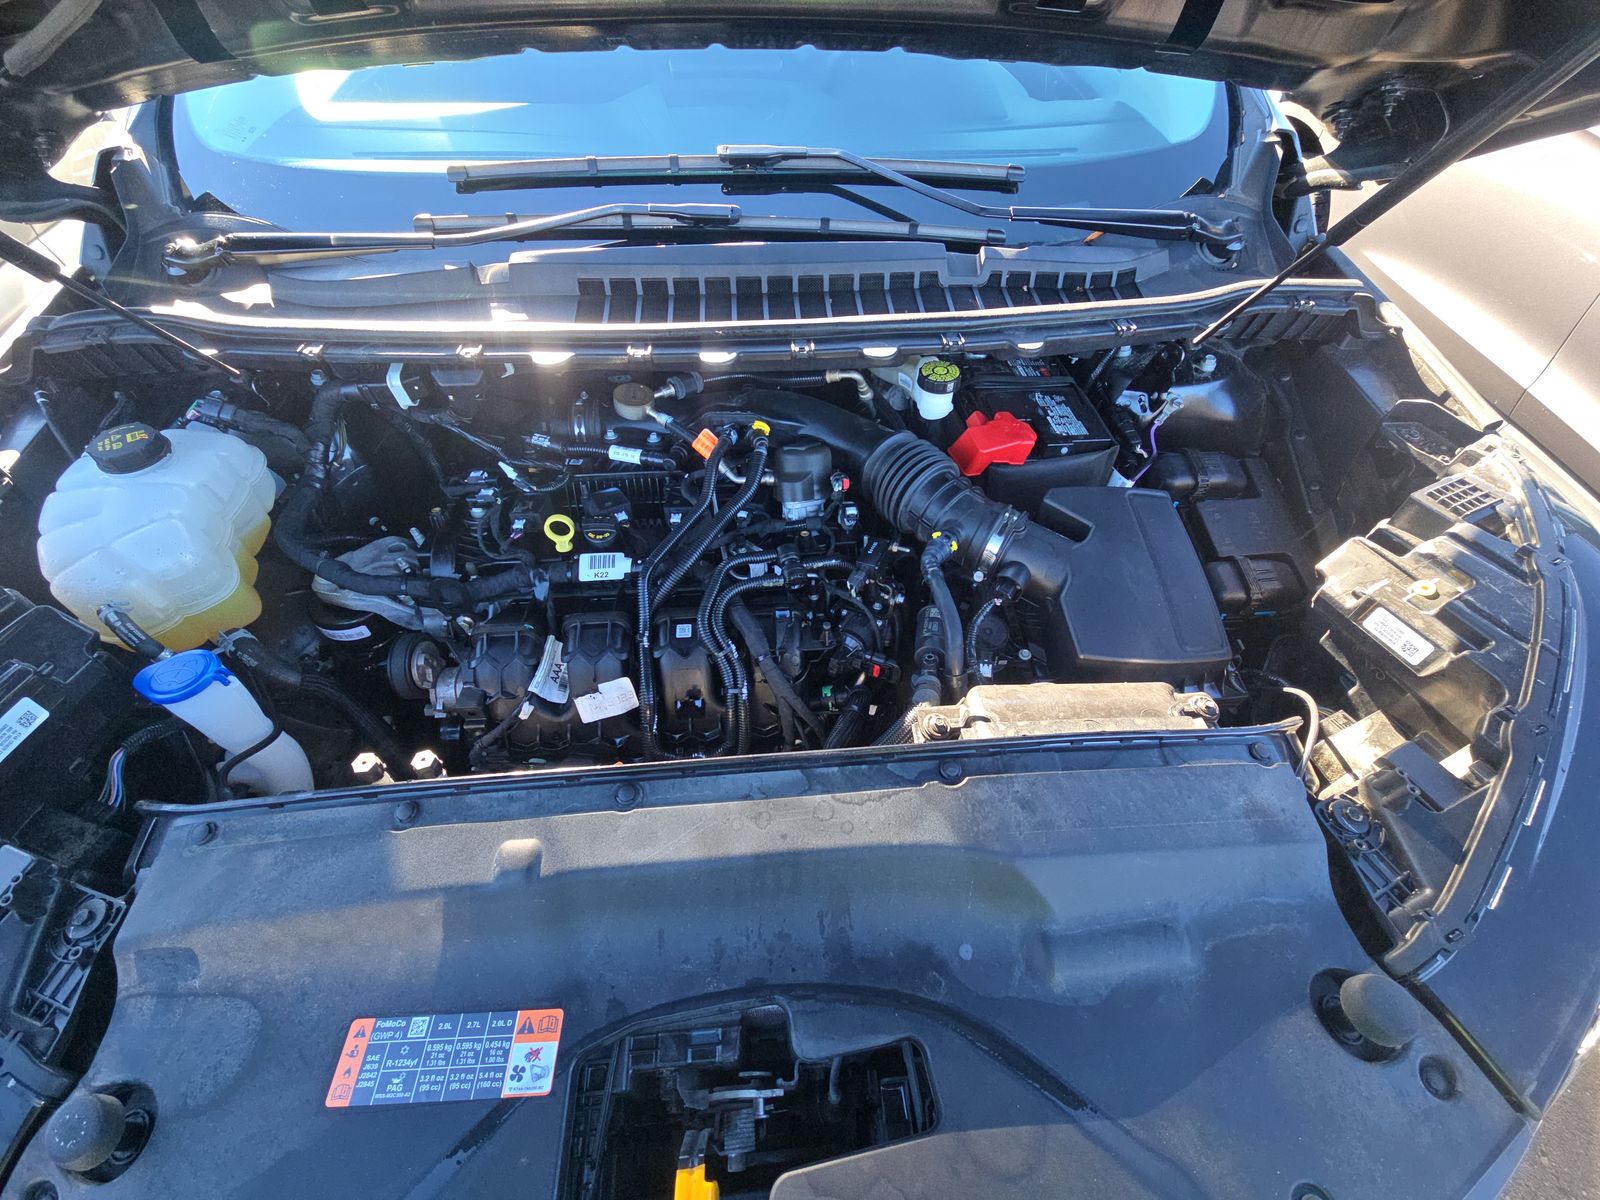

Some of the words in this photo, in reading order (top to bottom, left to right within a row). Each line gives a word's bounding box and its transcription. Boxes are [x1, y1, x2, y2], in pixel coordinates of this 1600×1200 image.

[593, 571, 609, 579] K22
[550, 662, 565, 684] AAA
[376, 1020, 406, 1028] FoMoCo
[492, 1020, 505, 1028] 2.0L
[371, 1032, 394, 1041] (GWP
[444, 1043, 452, 1051] kg
[473, 1042, 481, 1050] kg
[502, 1041, 510, 1049] kg
[386, 1058, 418, 1067] R-1234yf
[386, 1084, 403, 1092] PAG
